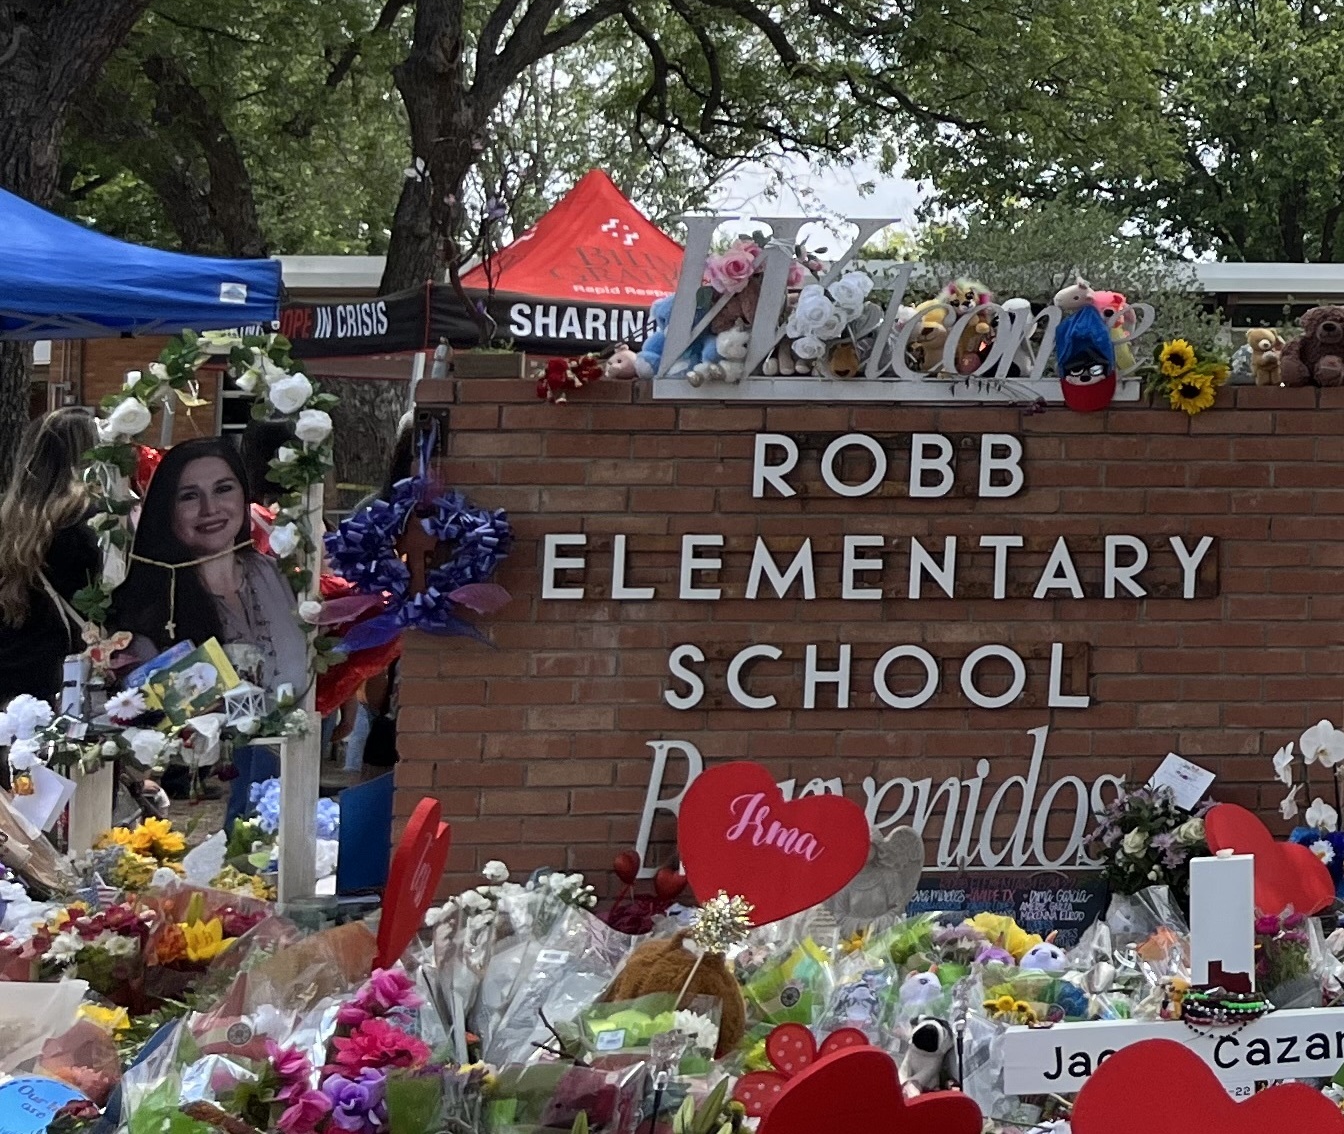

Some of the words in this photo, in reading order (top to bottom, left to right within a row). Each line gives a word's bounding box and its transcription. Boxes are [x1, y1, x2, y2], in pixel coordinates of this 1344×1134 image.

[281, 308, 312, 340] OPE
[315, 306, 331, 339] IN
[337, 301, 388, 338] CRISIS
[752, 433, 1025, 498] ROBB
[541, 534, 1215, 600] ELEMENTARY
[664, 643, 1091, 710] SCHOOL
[726, 792, 827, 862] Irma
